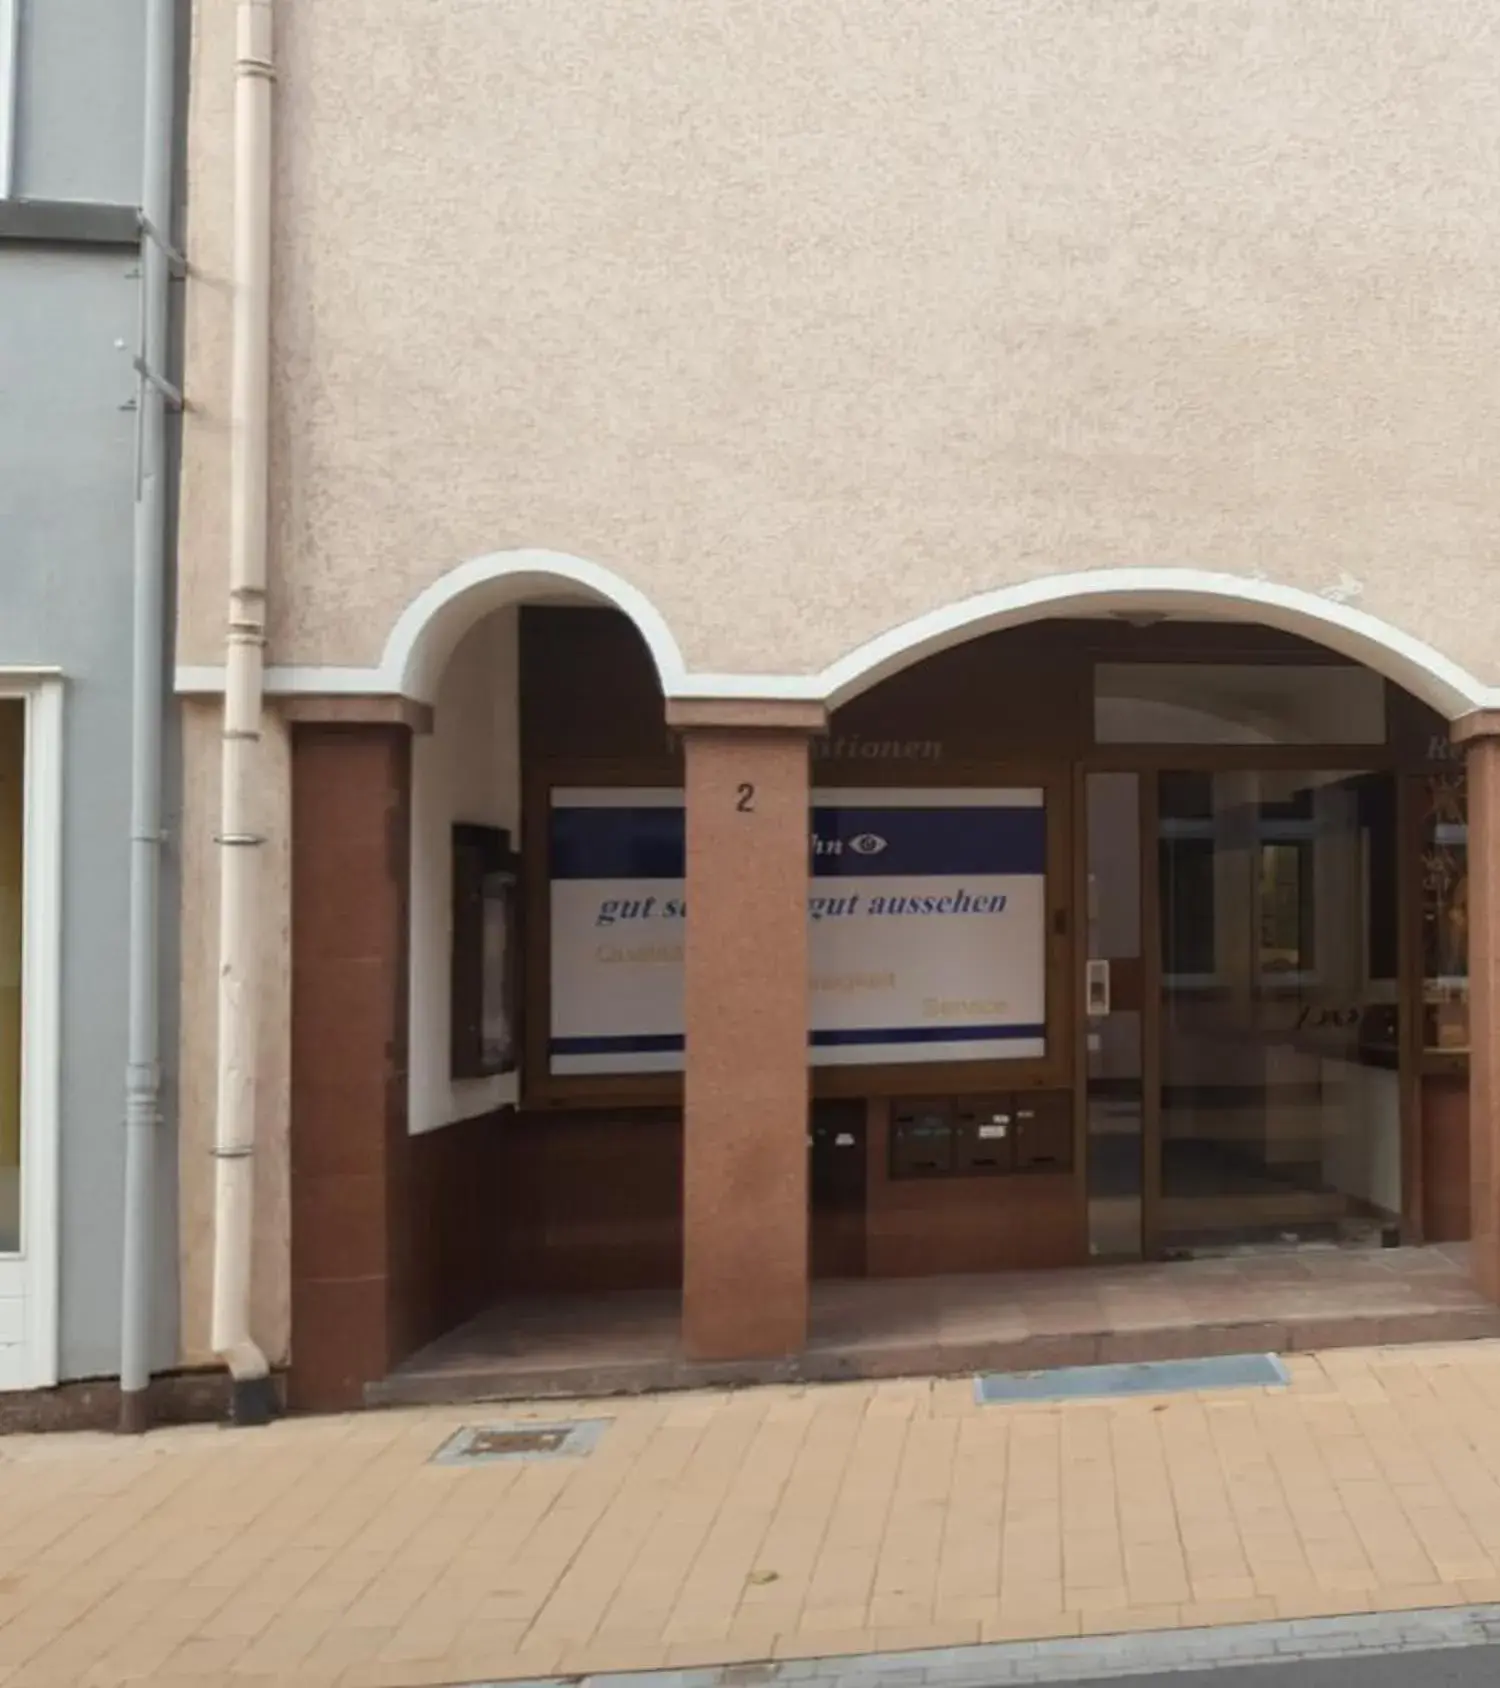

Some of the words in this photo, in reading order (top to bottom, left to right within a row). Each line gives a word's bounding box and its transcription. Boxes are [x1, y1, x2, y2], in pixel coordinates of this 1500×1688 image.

[737, 783, 754, 812] 2
[594, 894, 657, 926] gut
[809, 891, 860, 922] gut
[868, 887, 1008, 915] aussehen
